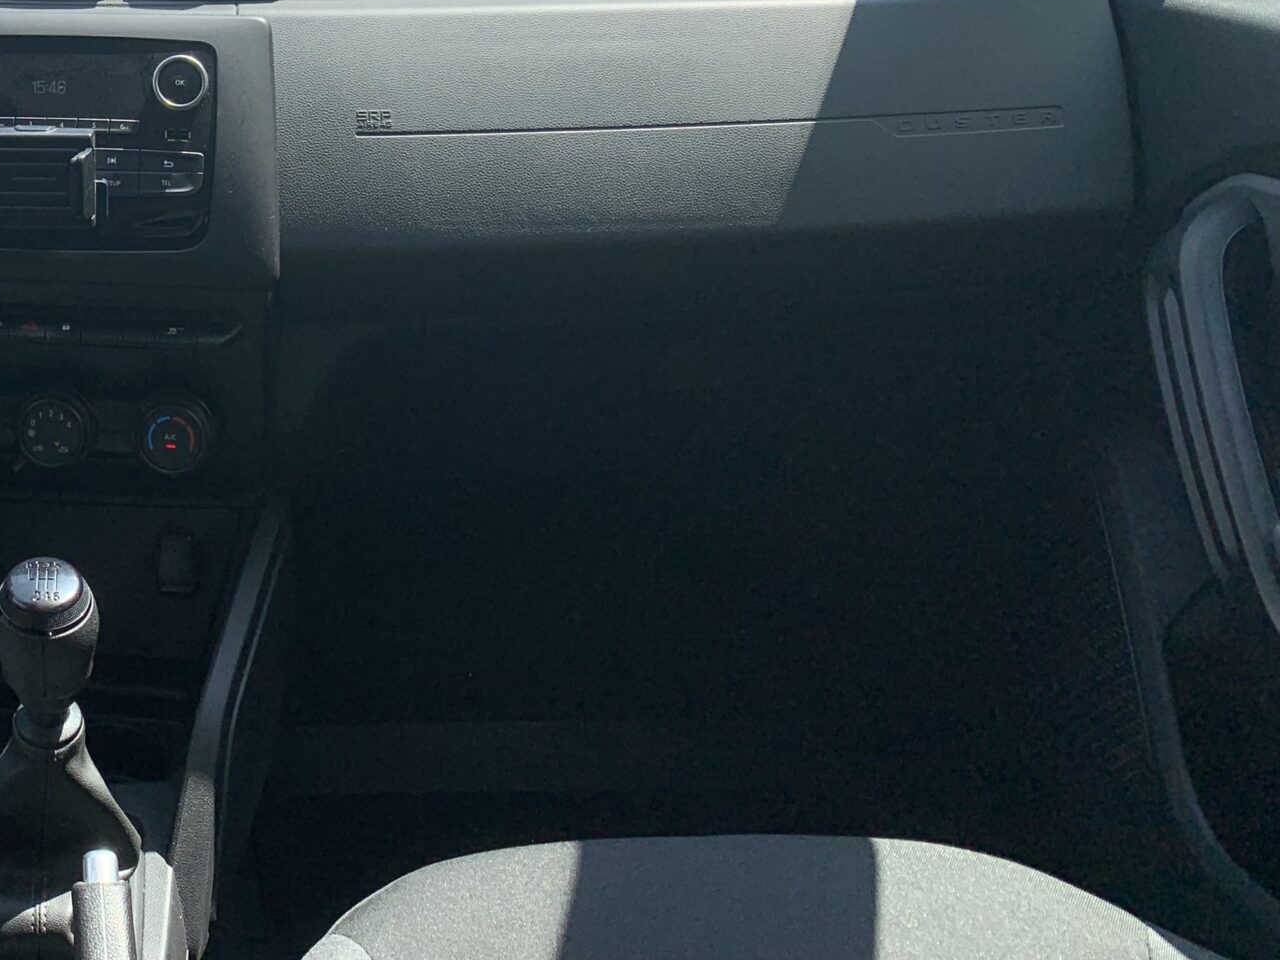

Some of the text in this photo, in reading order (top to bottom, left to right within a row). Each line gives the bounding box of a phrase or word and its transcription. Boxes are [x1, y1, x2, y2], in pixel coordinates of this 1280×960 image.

[31, 79, 67, 95] 15:46
[174, 79, 185, 87] OK
[897, 111, 1058, 133] DUSTER
[161, 179, 171, 187] TEL
[163, 433, 177, 441] A/C
